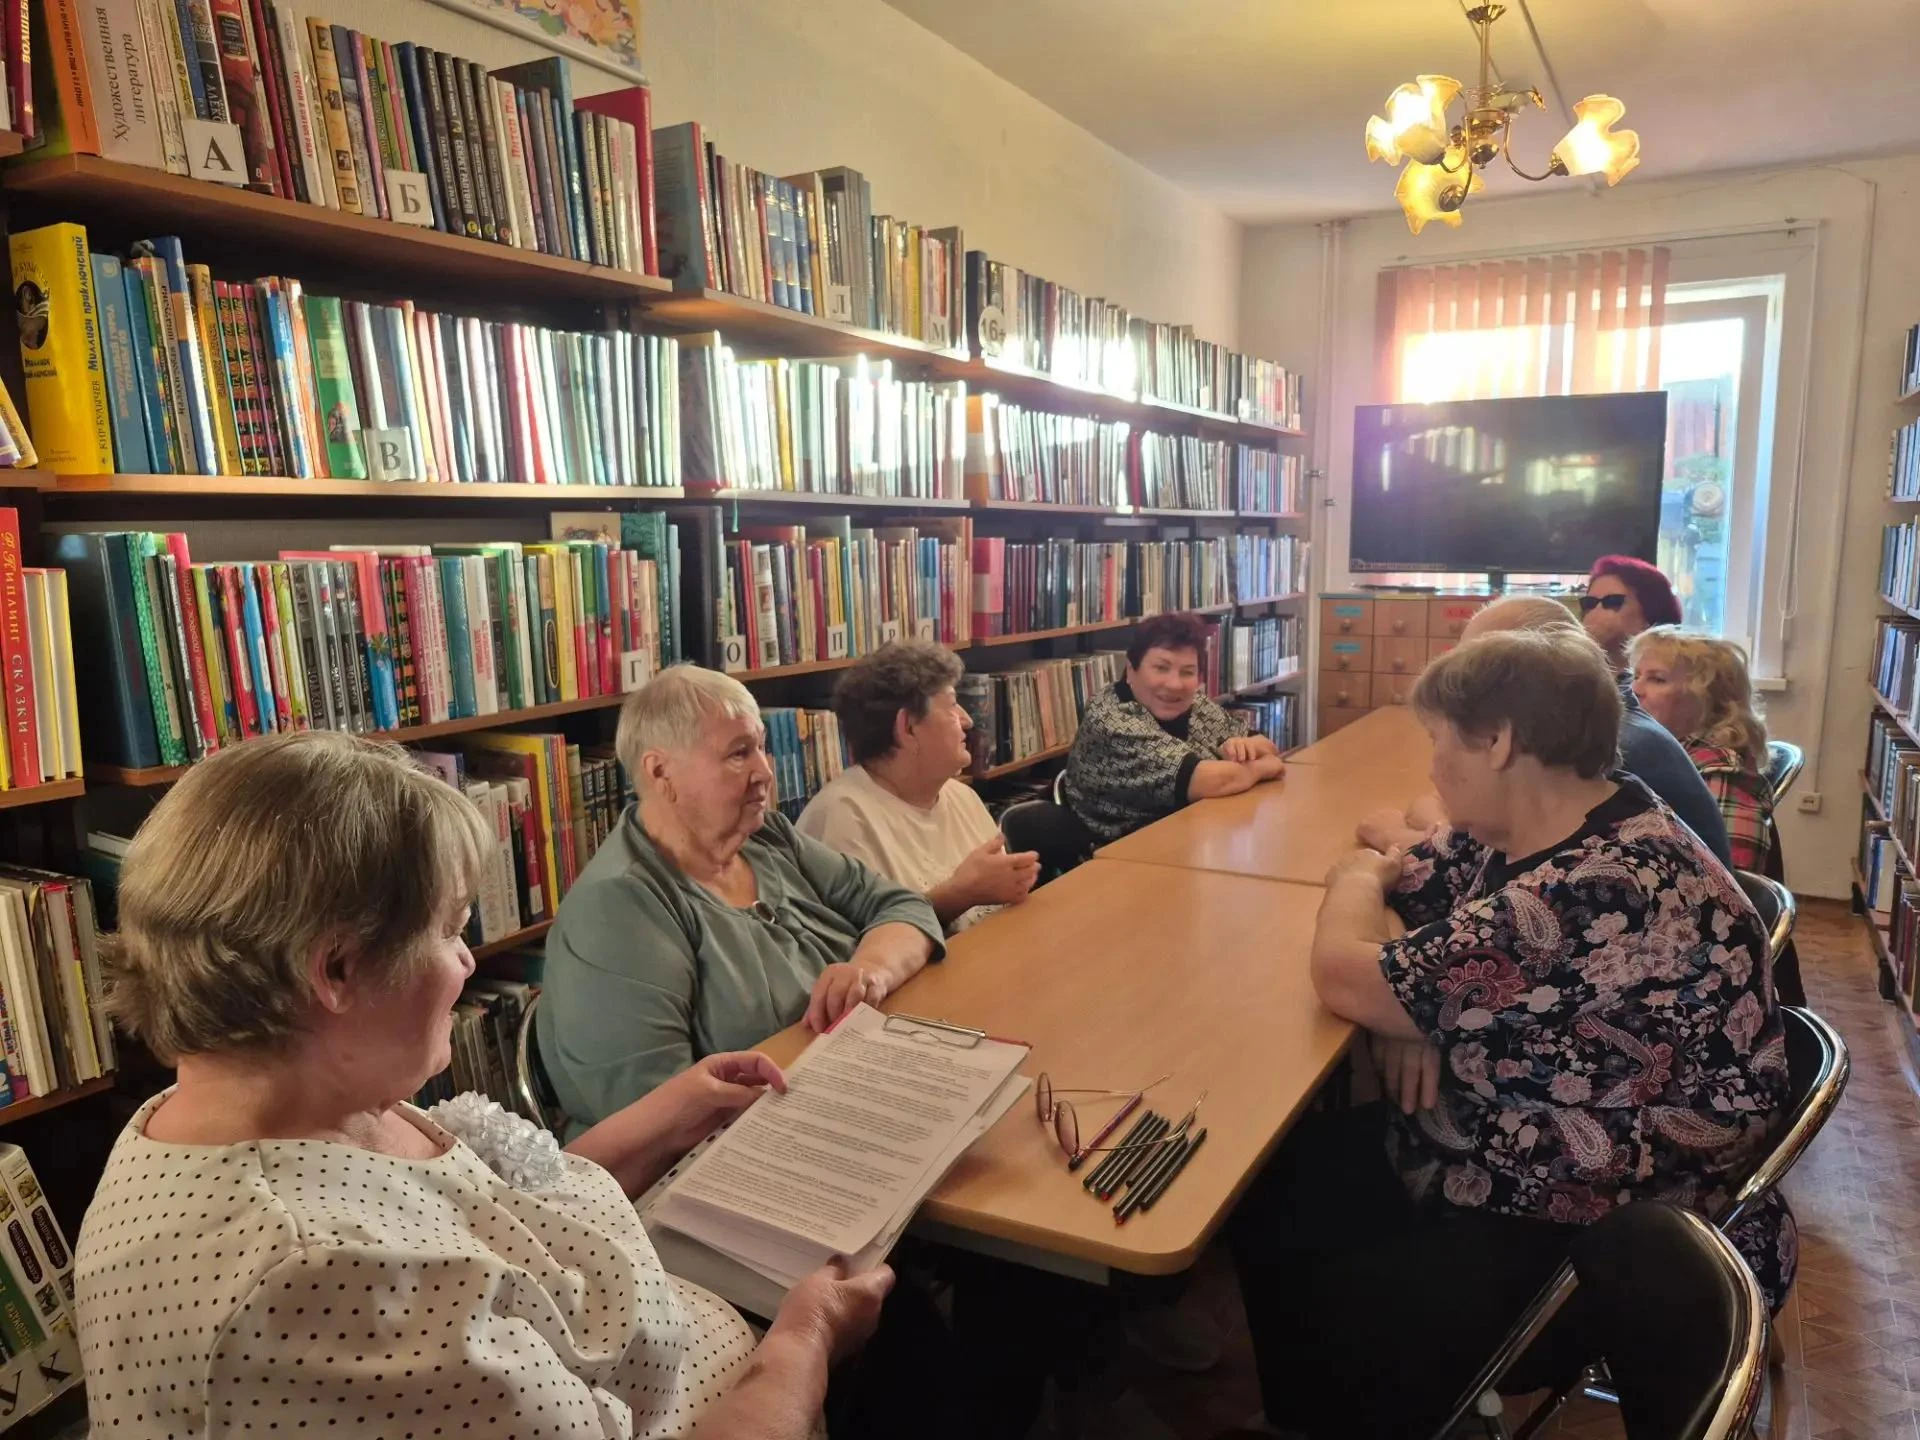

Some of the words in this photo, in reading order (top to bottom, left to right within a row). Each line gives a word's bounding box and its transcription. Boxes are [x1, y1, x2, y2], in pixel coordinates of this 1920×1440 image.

[20, 0, 32, 64] ВОЛШЕБ
[96, 8, 129, 142] Художественная
[122, 33, 147, 124] литература
[203, 136, 234, 171] А
[397, 183, 421, 215] Б
[72, 235, 94, 315] приключений
[832, 294, 845, 314] Л
[928, 322, 945, 342] М
[981, 318, 1006, 341] 16+
[86, 328, 99, 372] Миллион
[98, 427, 108, 451] КИР
[379, 441, 400, 471] В
[3, 552, 21, 643] КИПЛИНГ
[186, 609, 199, 653] ПОДАРОК
[832, 631, 843, 652] П
[726, 642, 741, 663] О
[630, 659, 642, 683] Г
[11, 654, 28, 734] СКАЗКИ
[38, 1350, 72, 1384] Х
[0, 1369, 23, 1417] У
